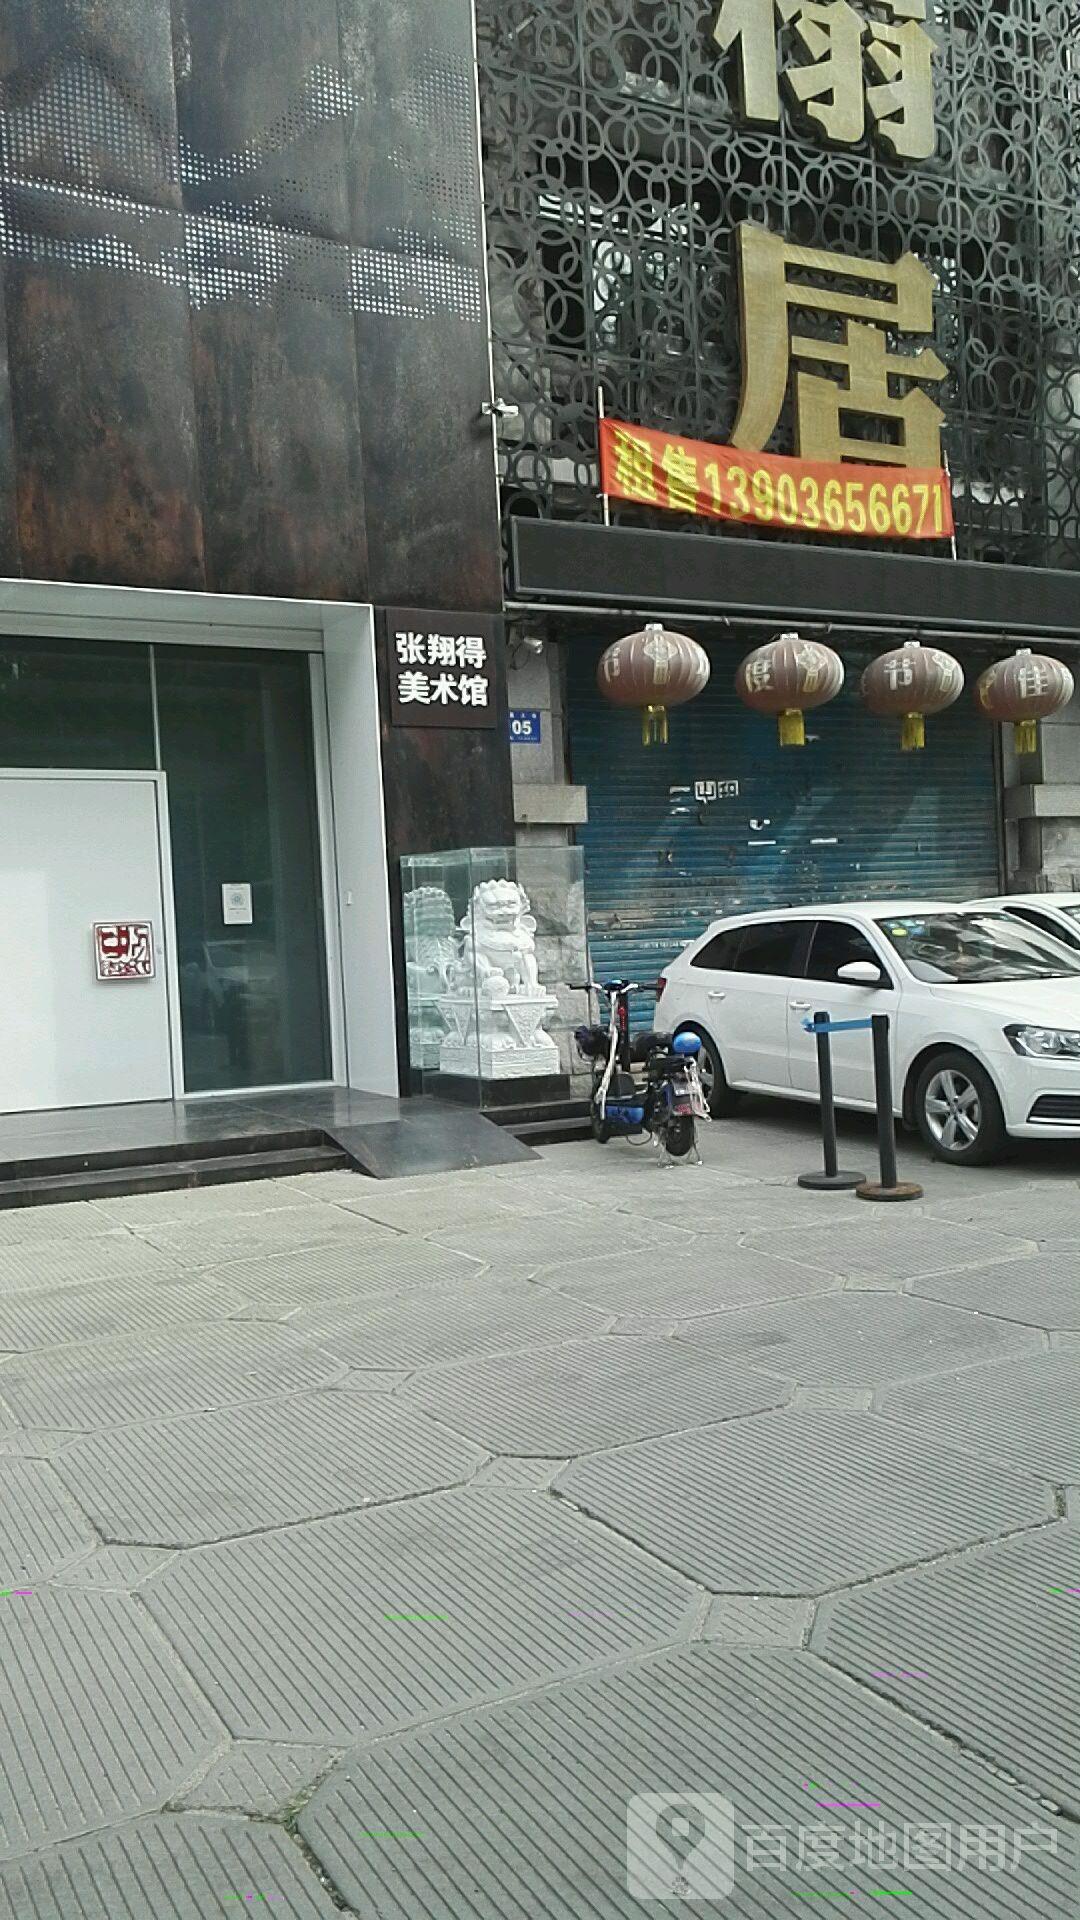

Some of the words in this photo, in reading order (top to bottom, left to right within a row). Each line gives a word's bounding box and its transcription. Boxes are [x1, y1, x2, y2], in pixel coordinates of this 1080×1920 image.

[395, 632, 487, 669] 张翔得
[397, 669, 489, 707] 美术馆
[1018, 665, 1049, 699] 佳
